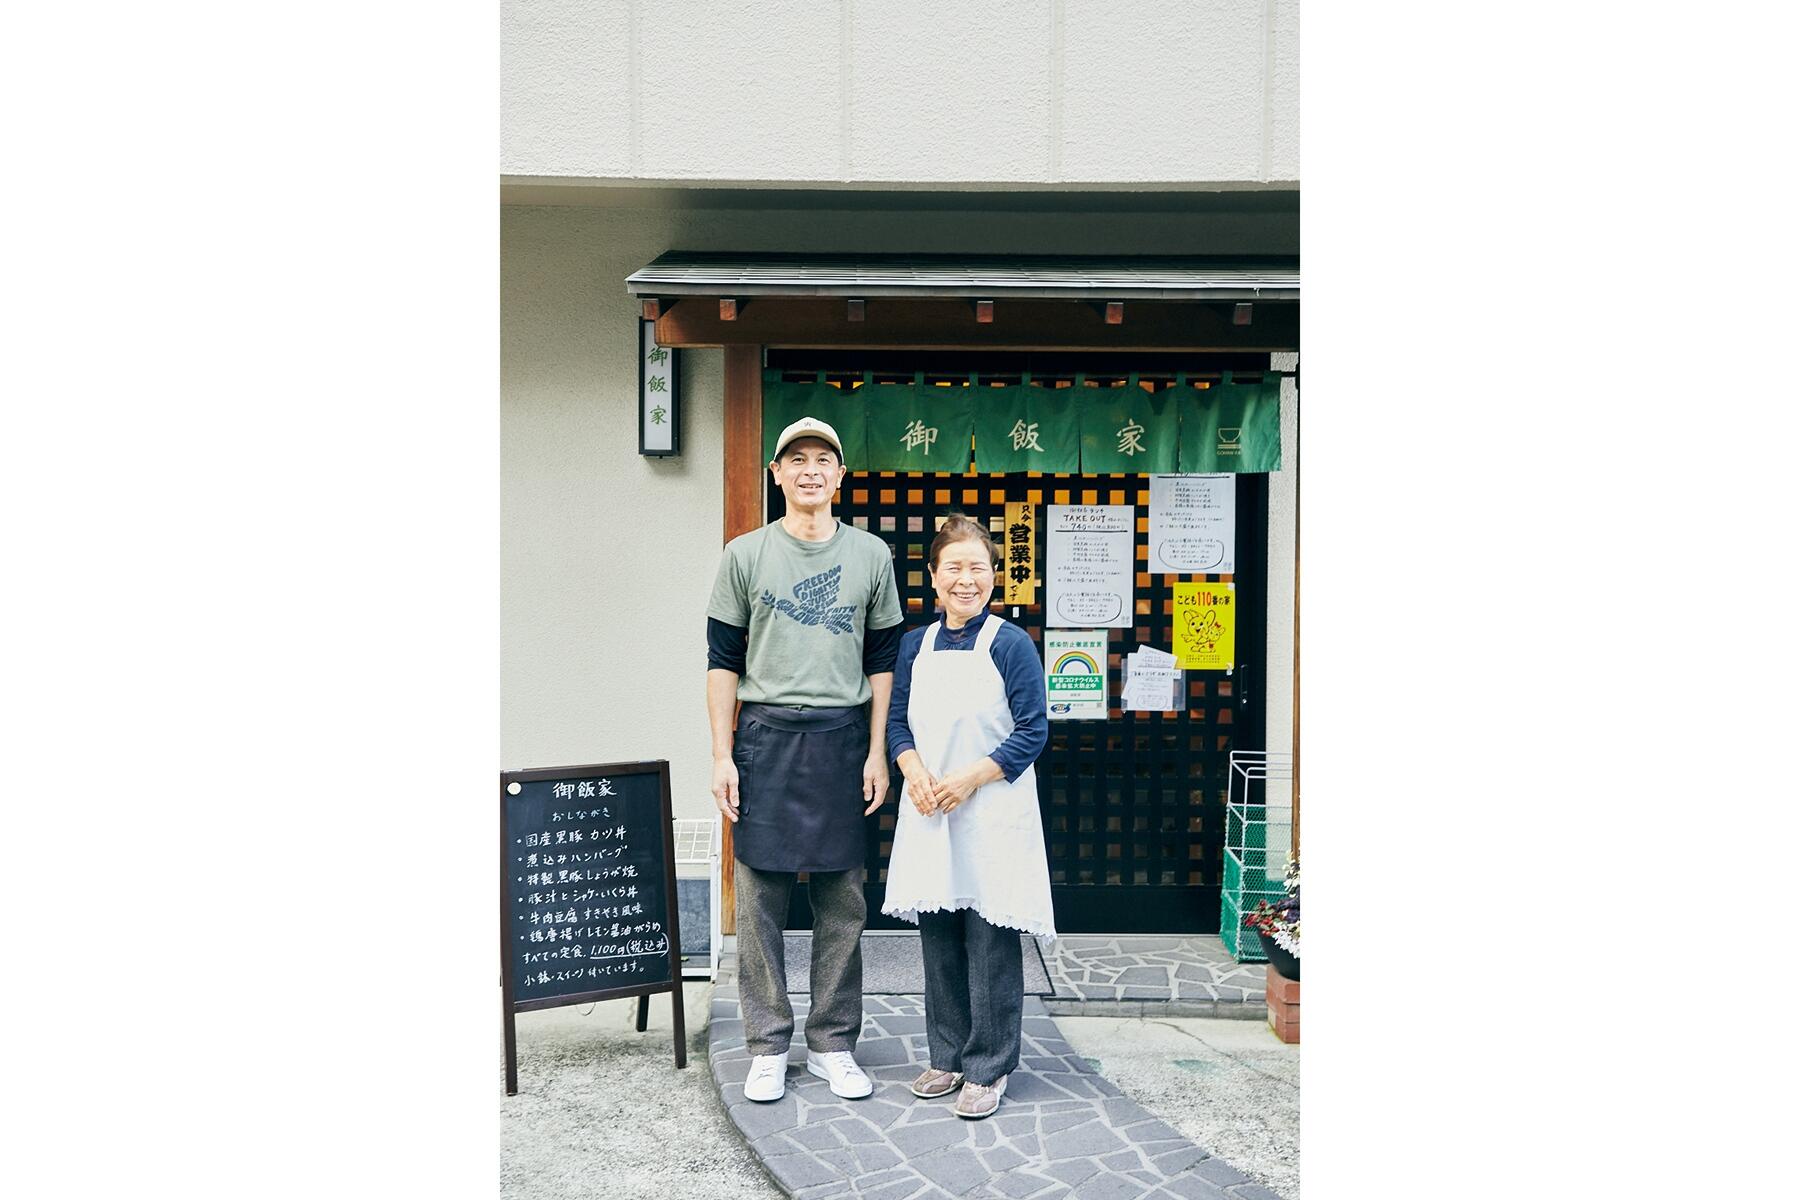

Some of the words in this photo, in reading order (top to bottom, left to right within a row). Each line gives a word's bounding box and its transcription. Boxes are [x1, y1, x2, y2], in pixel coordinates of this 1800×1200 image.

[647, 347, 668, 425] 御飯家
[899, 418, 1147, 455] 御飯家
[1063, 514, 1088, 522] TAKE
[1089, 514, 1106, 523] OUT
[1008, 522, 1032, 585] 営業中
[793, 565, 842, 599] FREEDOM
[801, 575, 841, 601] DIGNITY
[1177, 592, 1230, 606] こども110番の家
[552, 778, 618, 800] 御飯家
[552, 807, 611, 821] おしながき
[526, 844, 628, 868] 煮込みハンバーグ
